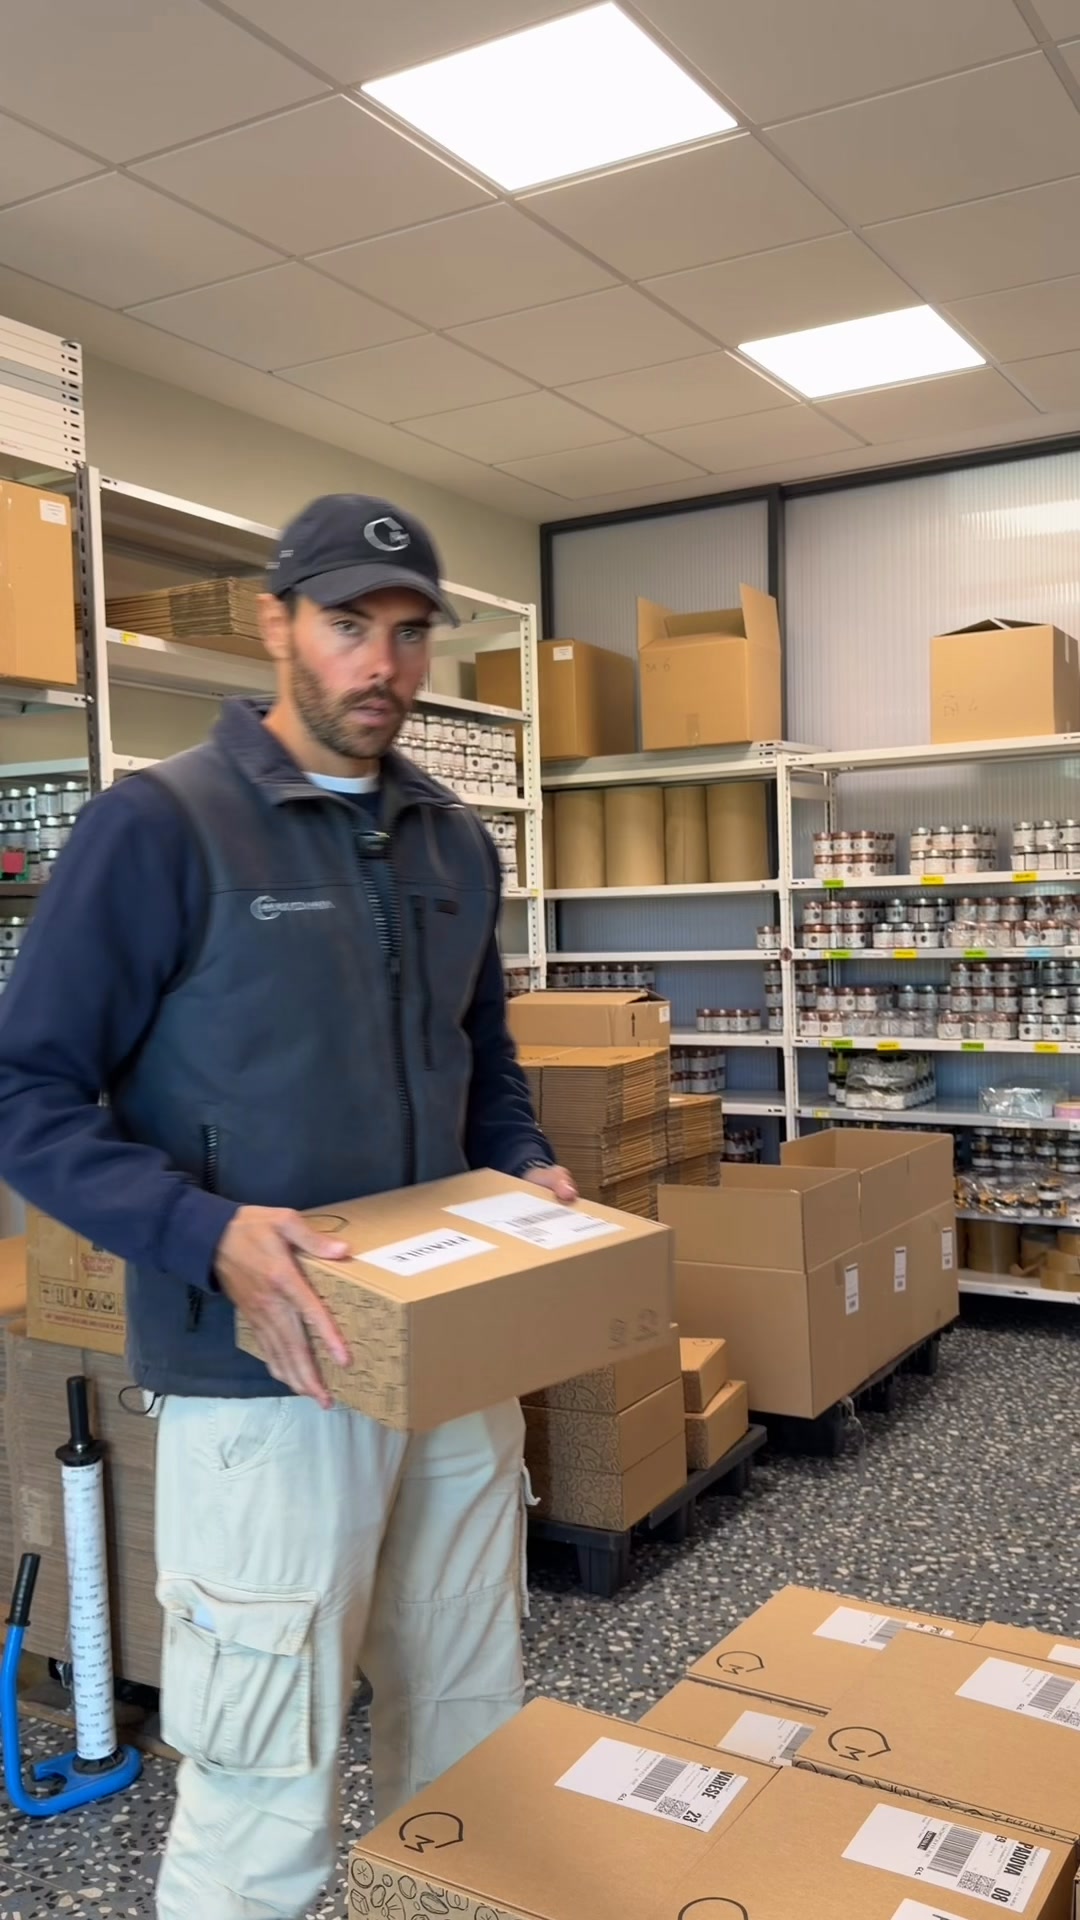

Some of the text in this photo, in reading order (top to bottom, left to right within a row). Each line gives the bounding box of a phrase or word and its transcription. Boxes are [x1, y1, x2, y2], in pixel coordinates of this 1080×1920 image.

[701, 1770, 735, 1799] VARESE
[682, 1810, 702, 1823] 23
[1003, 1841, 1034, 1876] PADOVA
[991, 1887, 1011, 1902] 08
